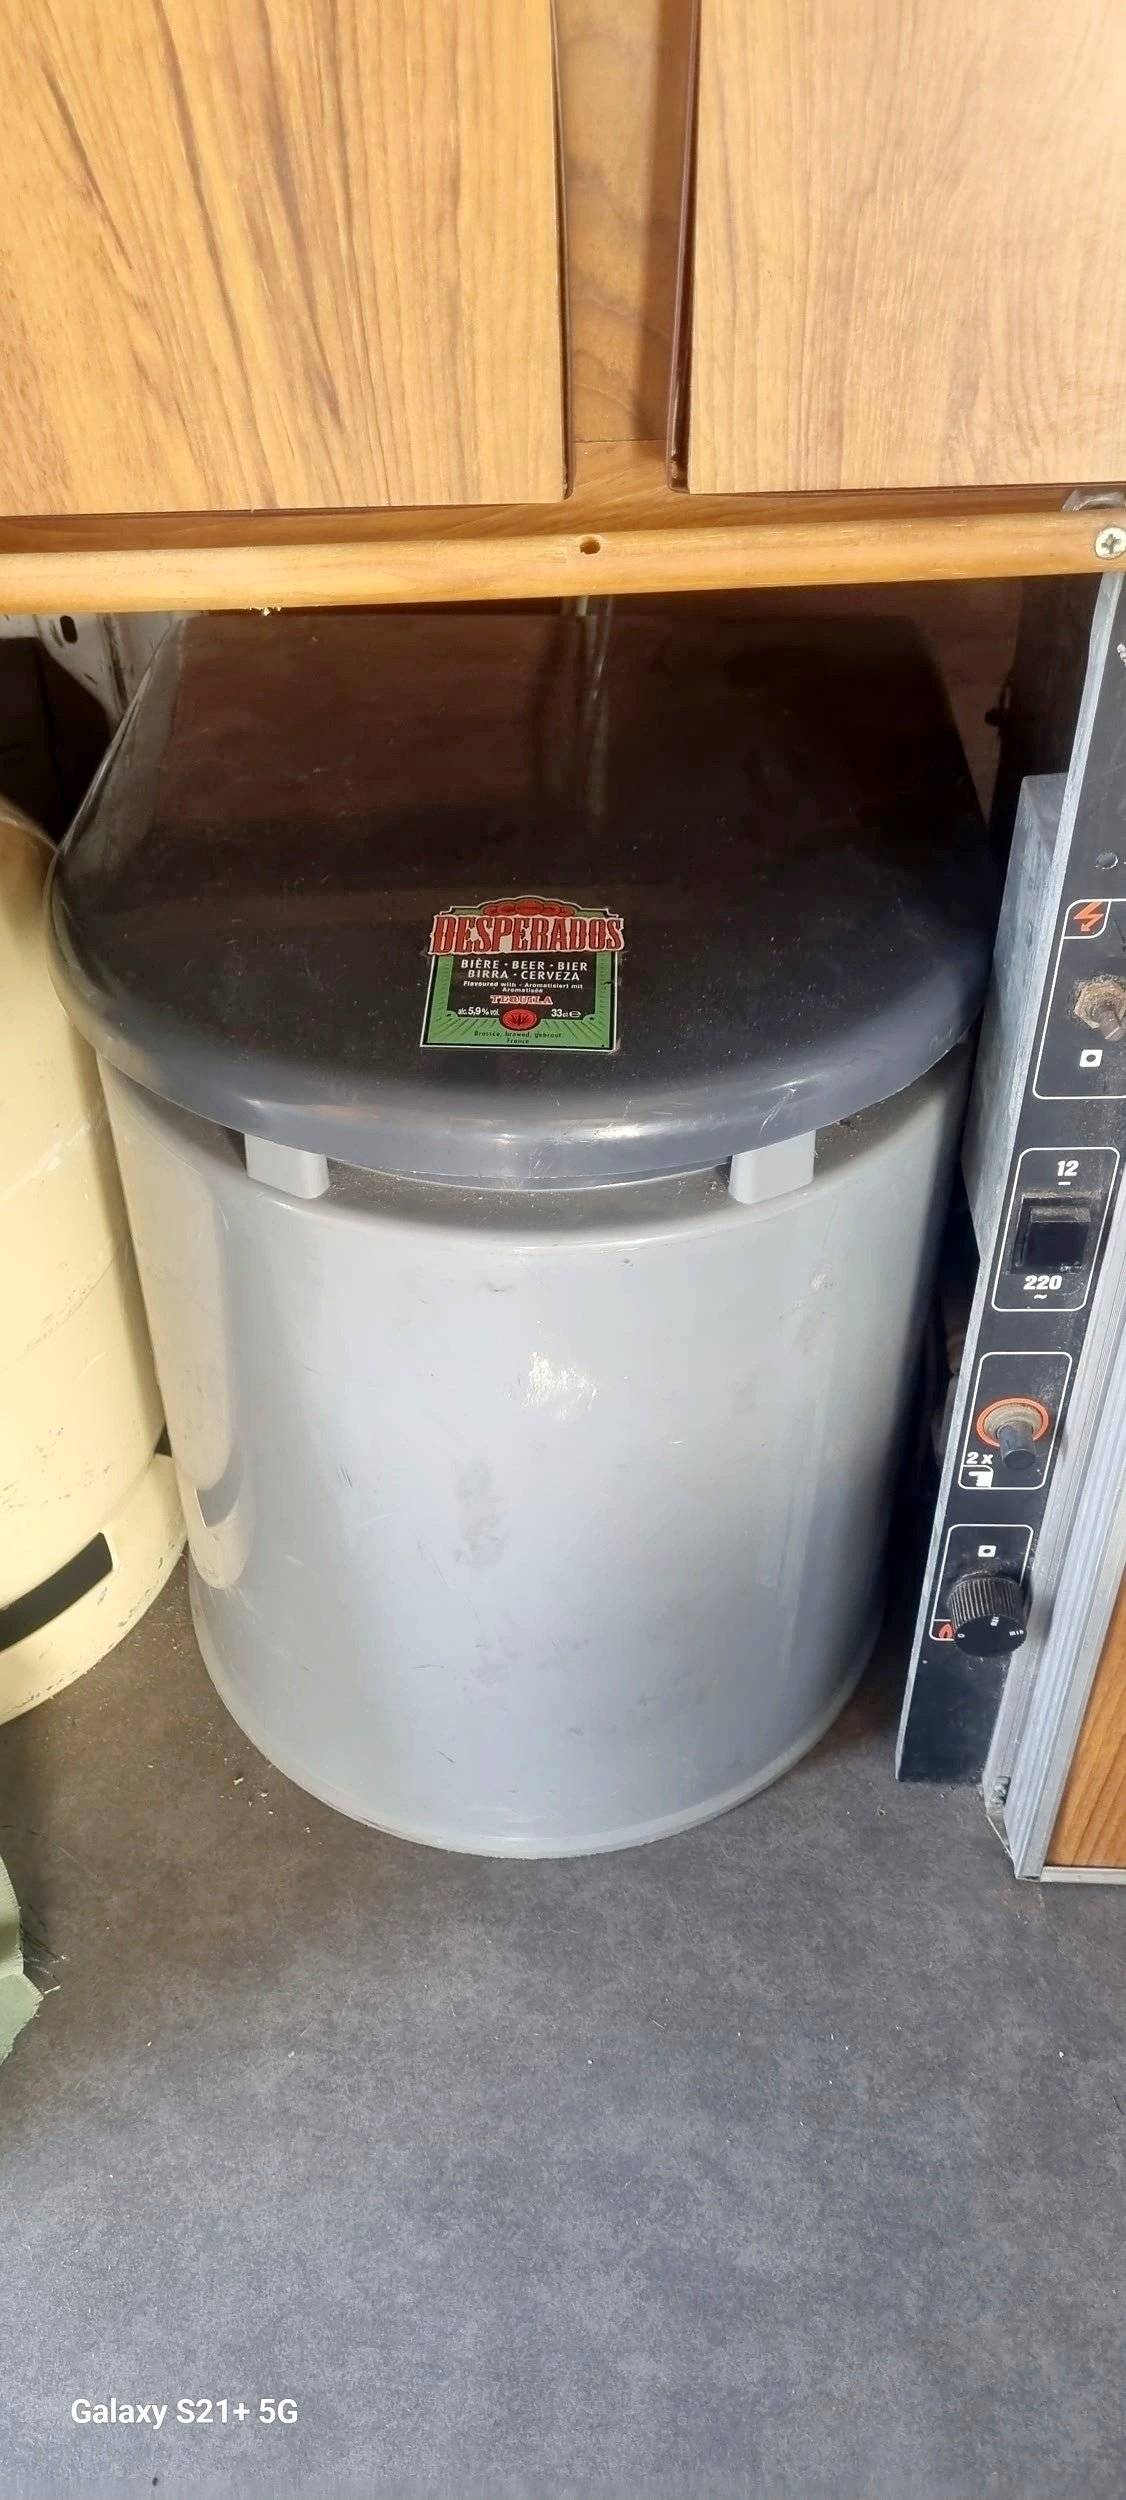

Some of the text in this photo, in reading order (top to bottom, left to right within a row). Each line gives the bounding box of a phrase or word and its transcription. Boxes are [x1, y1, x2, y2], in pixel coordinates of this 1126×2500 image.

[430, 916, 624, 955] DESPERADOS
[460, 958, 588, 971] BIÈRE BEER BIER
[468, 970, 580, 981] BIRRA CERVEZA
[490, 994, 553, 1005] TEQUILA
[1057, 1160, 1079, 1177] 12
[1023, 1275, 1063, 1290] 220
[965, 1451, 993, 1464] 2 x
